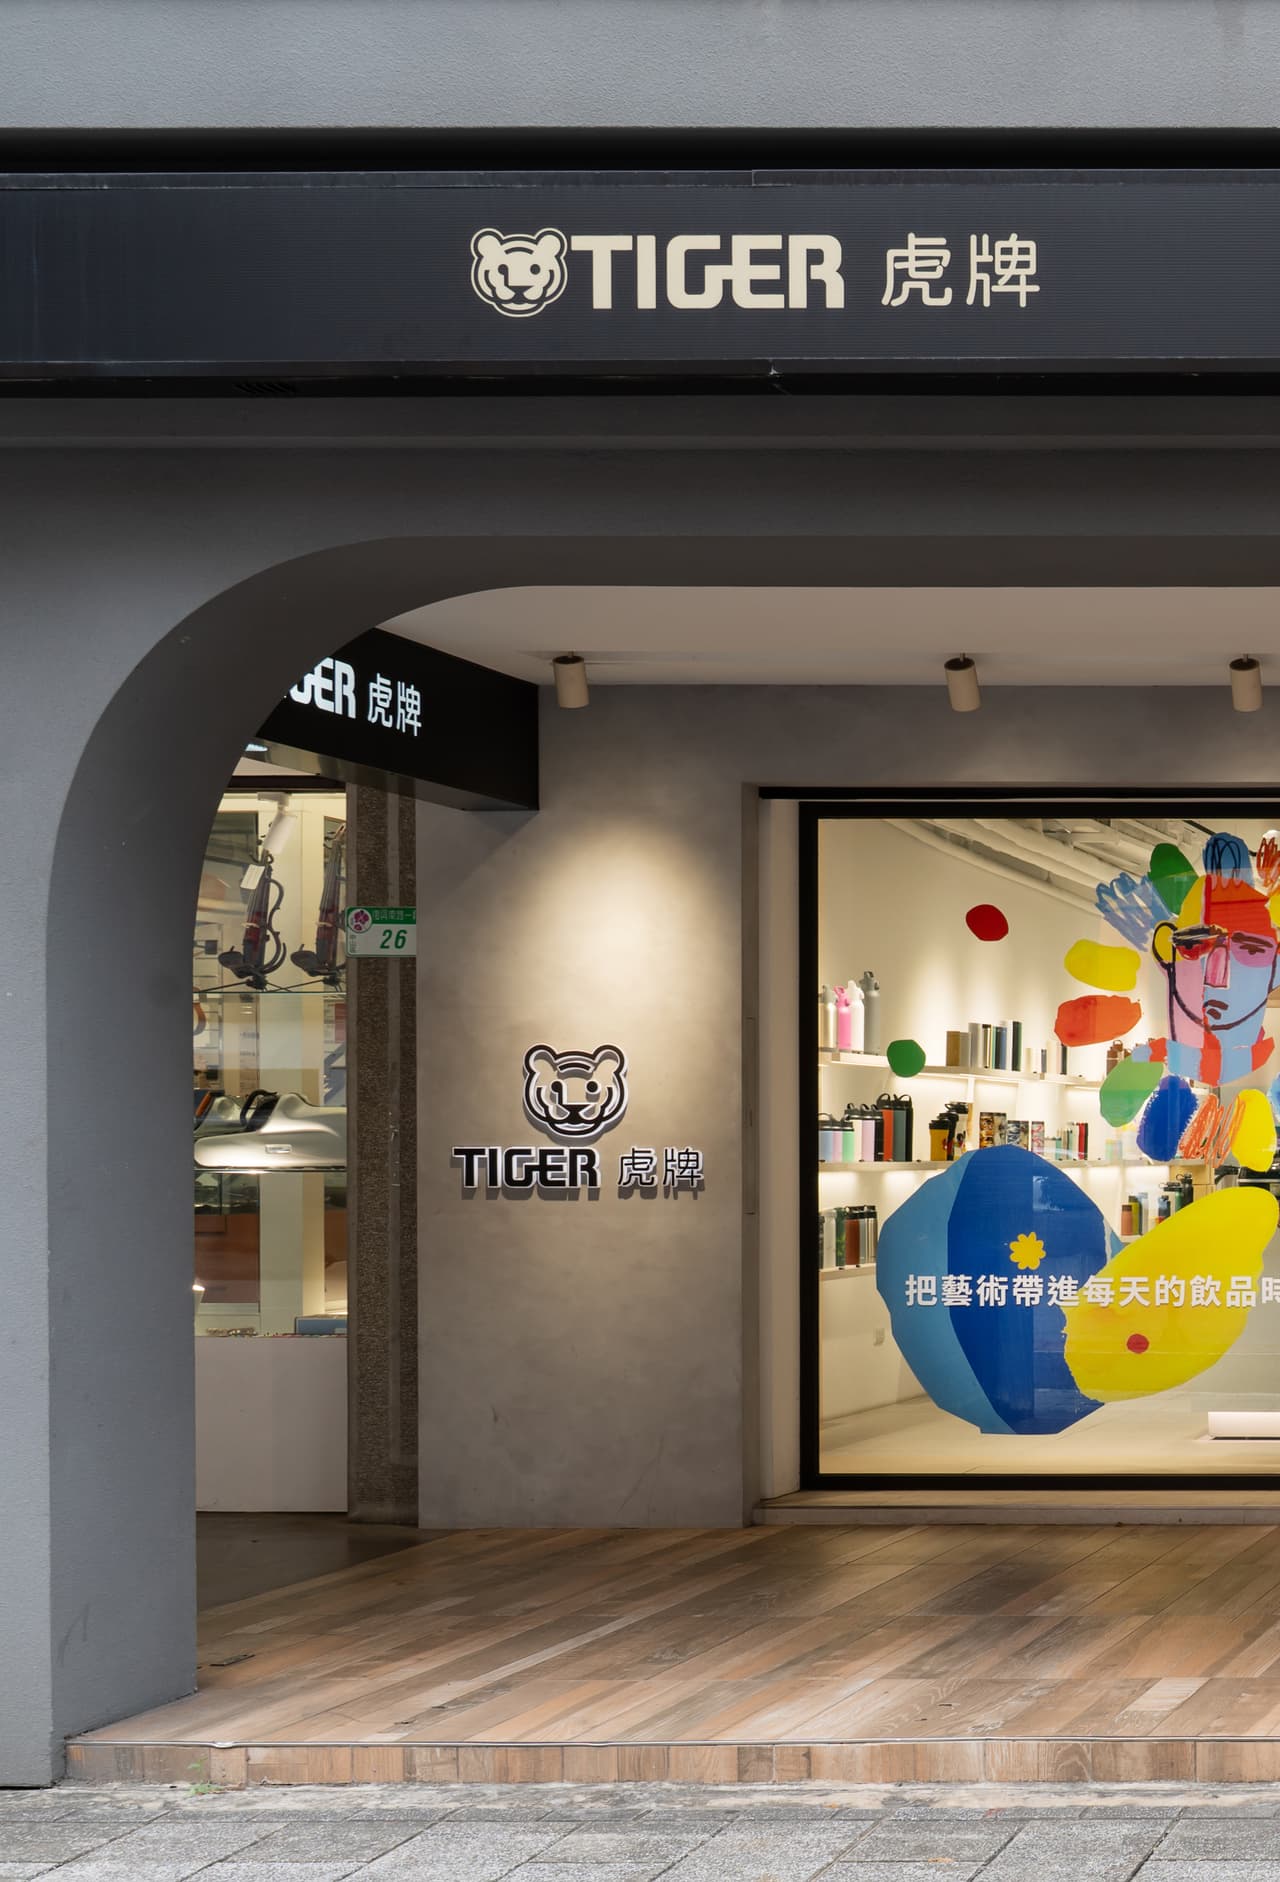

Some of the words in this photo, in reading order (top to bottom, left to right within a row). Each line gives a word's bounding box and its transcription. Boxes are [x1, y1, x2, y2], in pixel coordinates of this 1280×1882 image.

[571, 234, 845, 309] TIGER
[881, 232, 1040, 307] 虎牌
[367, 672, 423, 737] 虎牌
[380, 929, 408, 950] 26
[452, 1146, 601, 1189] TIGER
[616, 1146, 706, 1189] 虎牌
